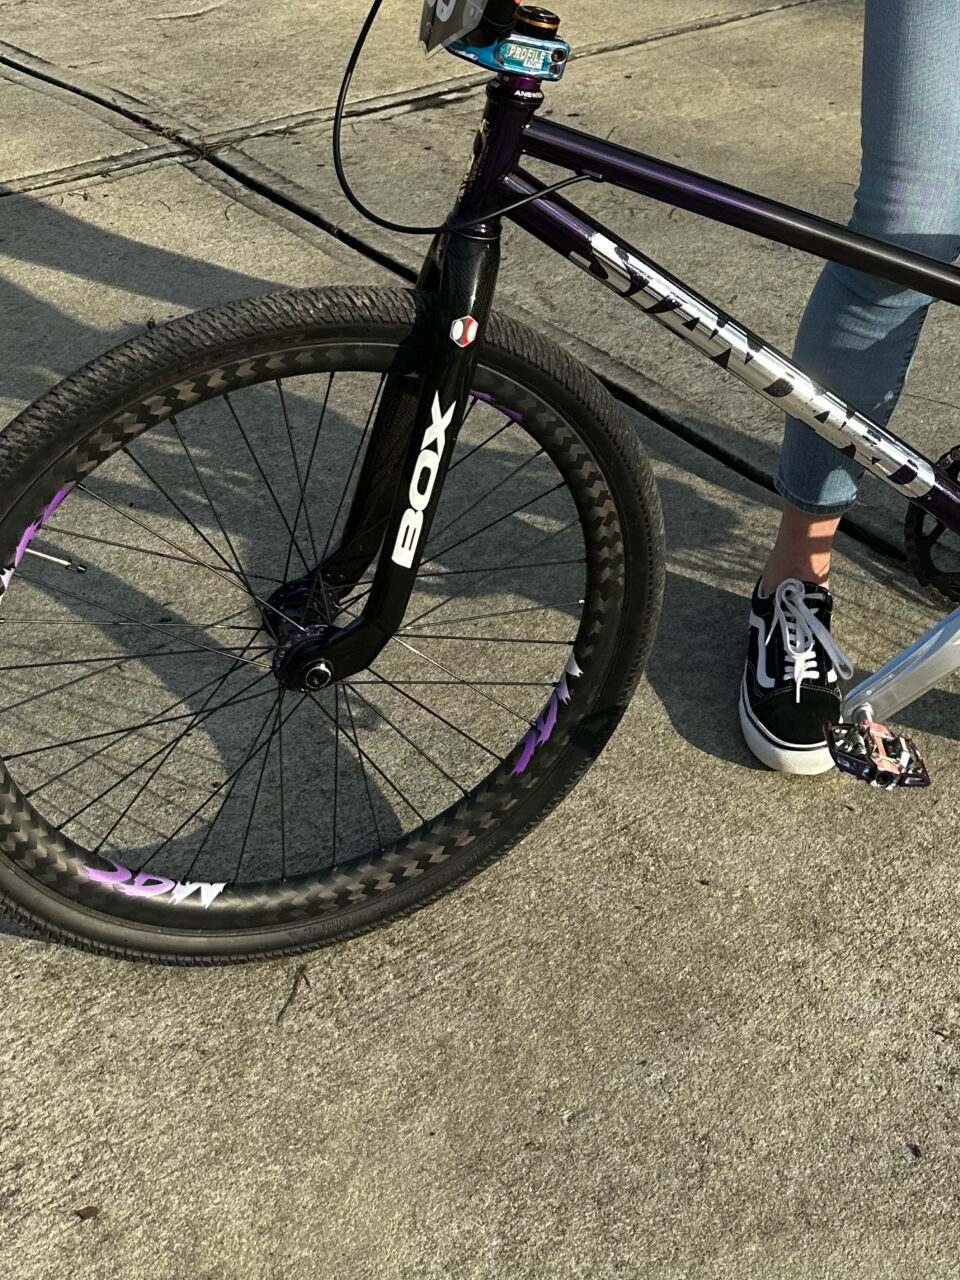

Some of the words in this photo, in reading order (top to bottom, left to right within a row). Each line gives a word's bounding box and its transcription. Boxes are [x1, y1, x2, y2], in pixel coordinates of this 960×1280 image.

[508, 45, 546, 64] PROFILE
[566, 231, 936, 499] STANDARD
[391, 390, 457, 569] BOX
